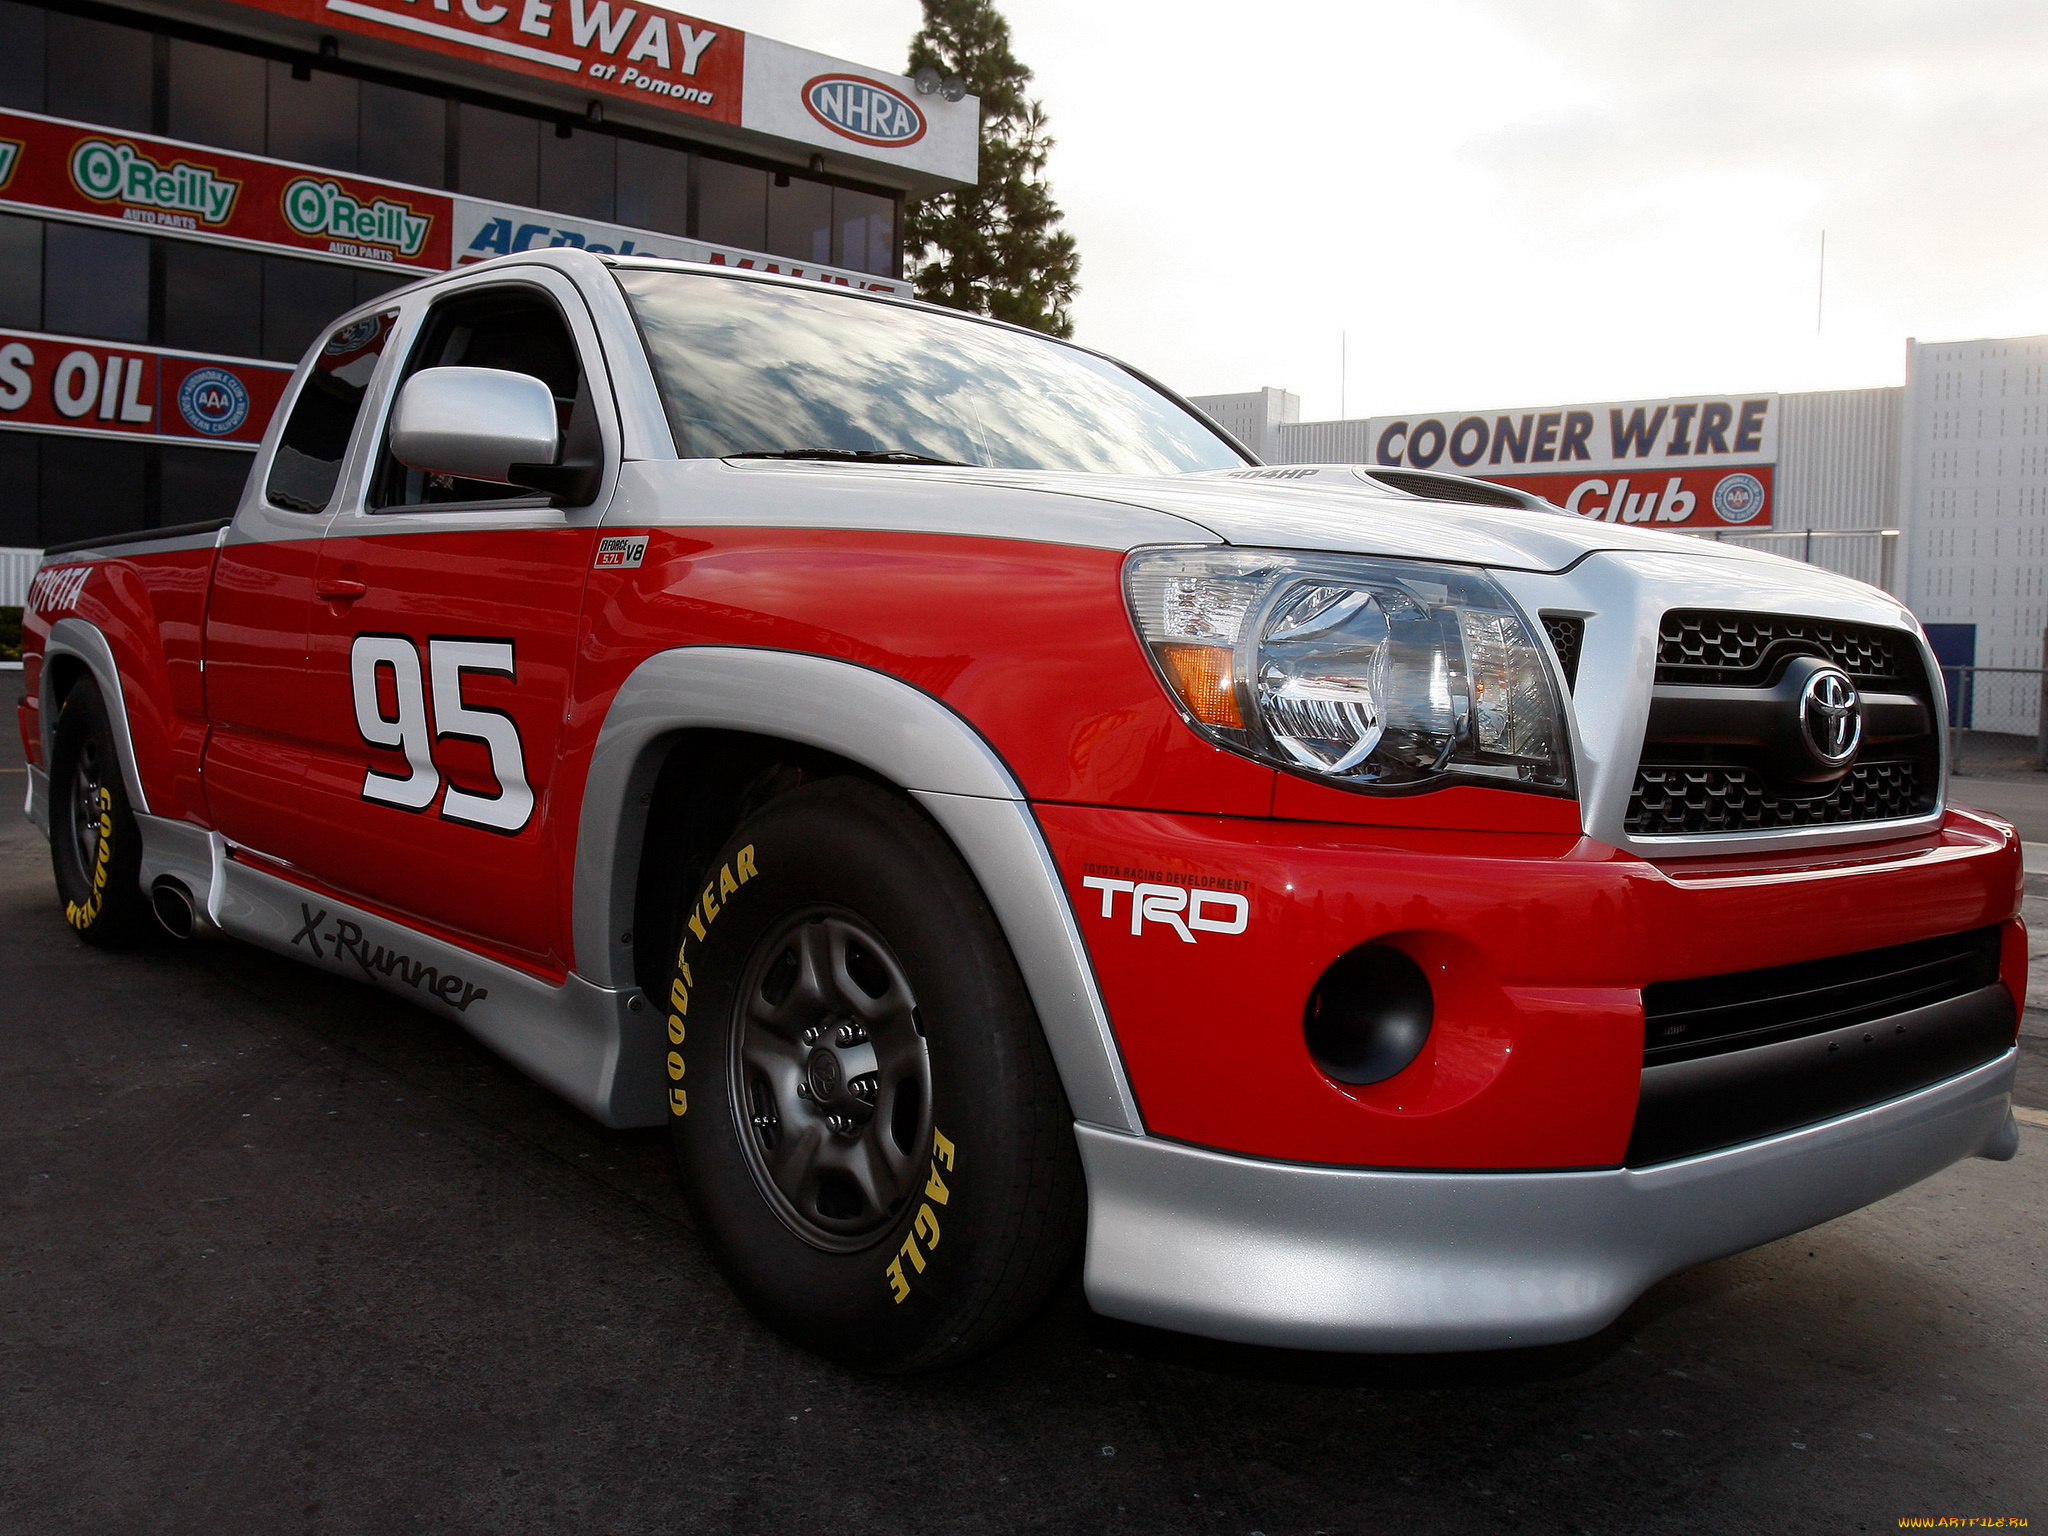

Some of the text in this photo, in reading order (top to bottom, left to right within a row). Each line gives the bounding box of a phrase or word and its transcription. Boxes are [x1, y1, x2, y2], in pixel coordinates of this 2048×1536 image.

[589, 63, 714, 105] at Pomona
[820, 84, 911, 136] NHRA
[76, 143, 236, 221] O'Reilly
[123, 208, 197, 231] AUTO PARTS
[287, 182, 430, 253] O'Reilly
[328, 242, 394, 262] AUTO PARTS
[53, 350, 153, 423] OIL
[198, 391, 229, 409] AAA
[1376, 399, 1769, 469] COONER WIRE
[1565, 477, 1697, 523] Club
[626, 544, 645, 561] V8
[28, 566, 94, 613] TOYOTA
[351, 631, 536, 837] 95
[1083, 863, 1249, 891] TOYOTA RACING DEVELOPMENT
[1083, 876, 1249, 944] TRD
[291, 902, 489, 1012] X-Runner
[886, 1126, 955, 1304] EAGLE
